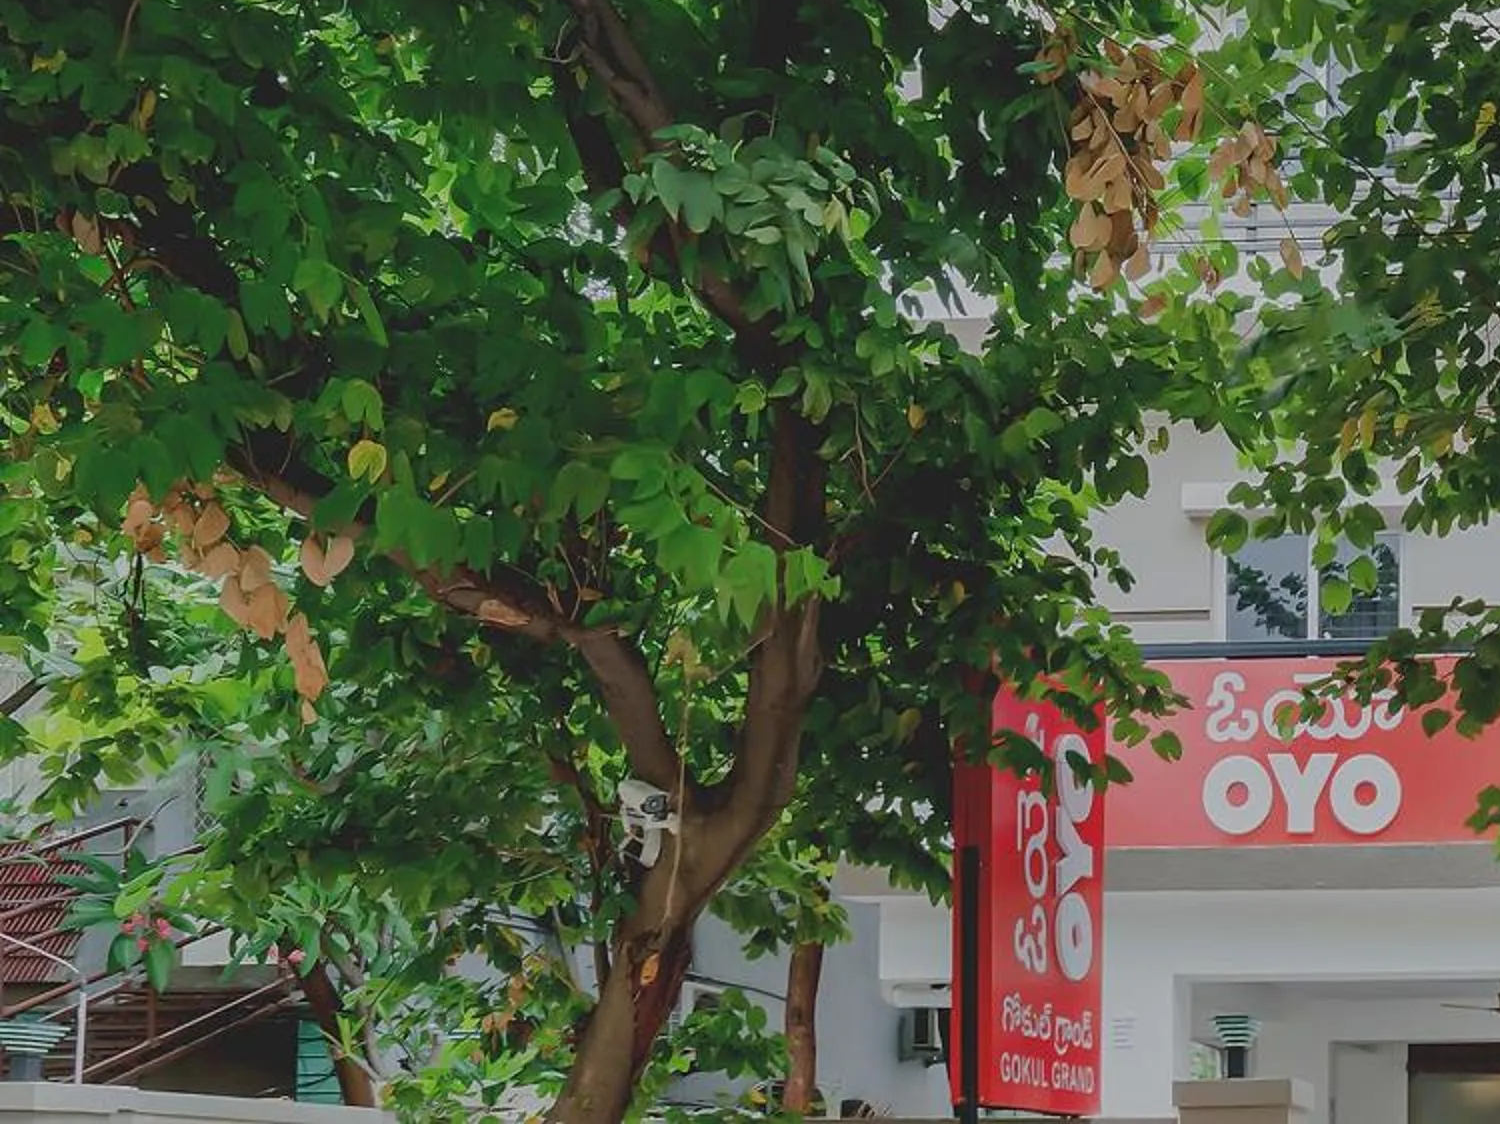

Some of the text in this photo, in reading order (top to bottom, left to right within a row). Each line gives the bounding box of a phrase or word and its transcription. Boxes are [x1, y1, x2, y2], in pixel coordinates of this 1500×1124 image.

[1202, 752, 1402, 835] OYO
[1054, 733, 1094, 981] OYO
[1001, 1051, 1095, 1095] GOKUL GRAND
